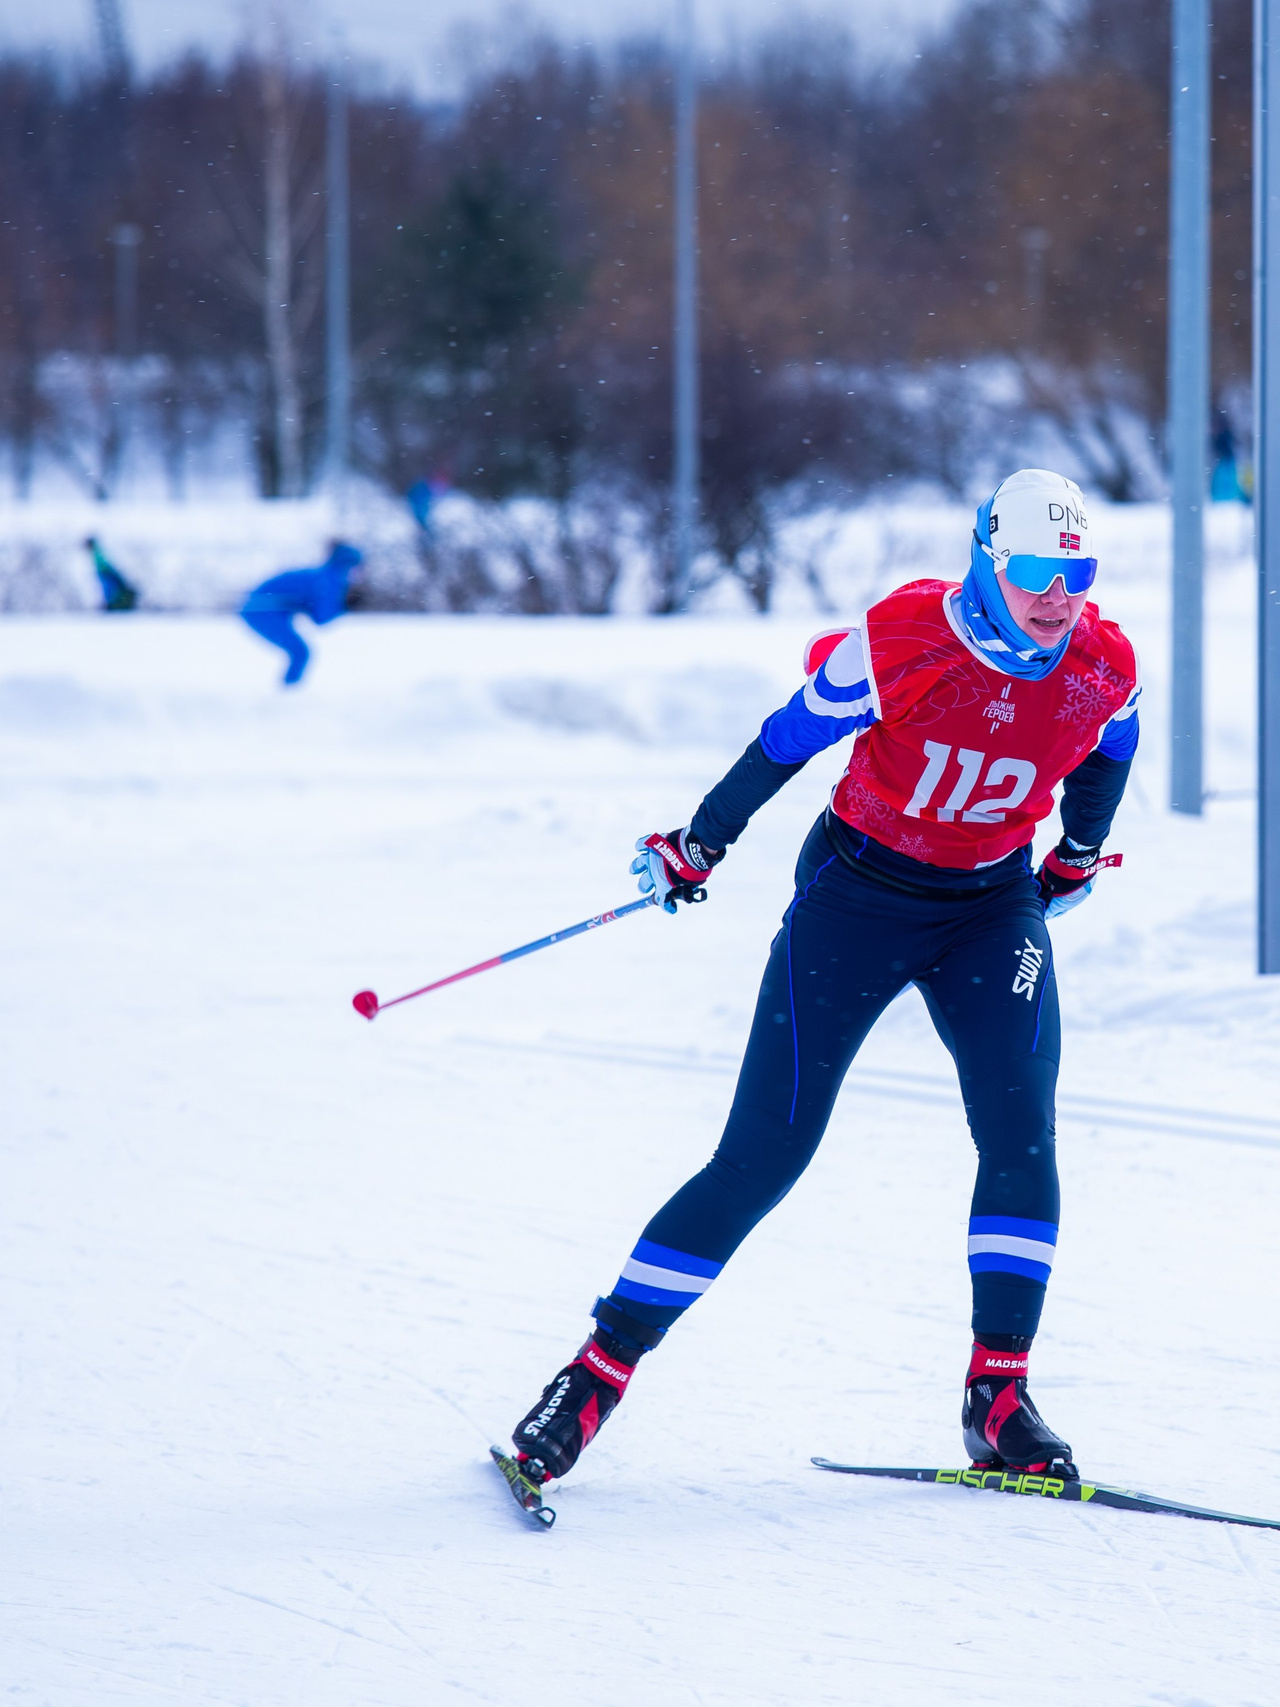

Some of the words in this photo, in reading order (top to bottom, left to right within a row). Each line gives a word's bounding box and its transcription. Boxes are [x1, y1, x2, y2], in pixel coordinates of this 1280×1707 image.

[1049, 497, 1088, 531] DNB
[982, 707, 1015, 723] ГЕРОЕВ
[988, 700, 1016, 712] ЛЫЖНЯ
[902, 739, 1037, 823] 112
[653, 841, 685, 872] START
[586, 1350, 629, 1382] MADSHUS
[985, 1358, 1028, 1368] MADSHU
[524, 1375, 571, 1437] MADSHUS
[935, 1469, 1065, 1498] FISCHER
